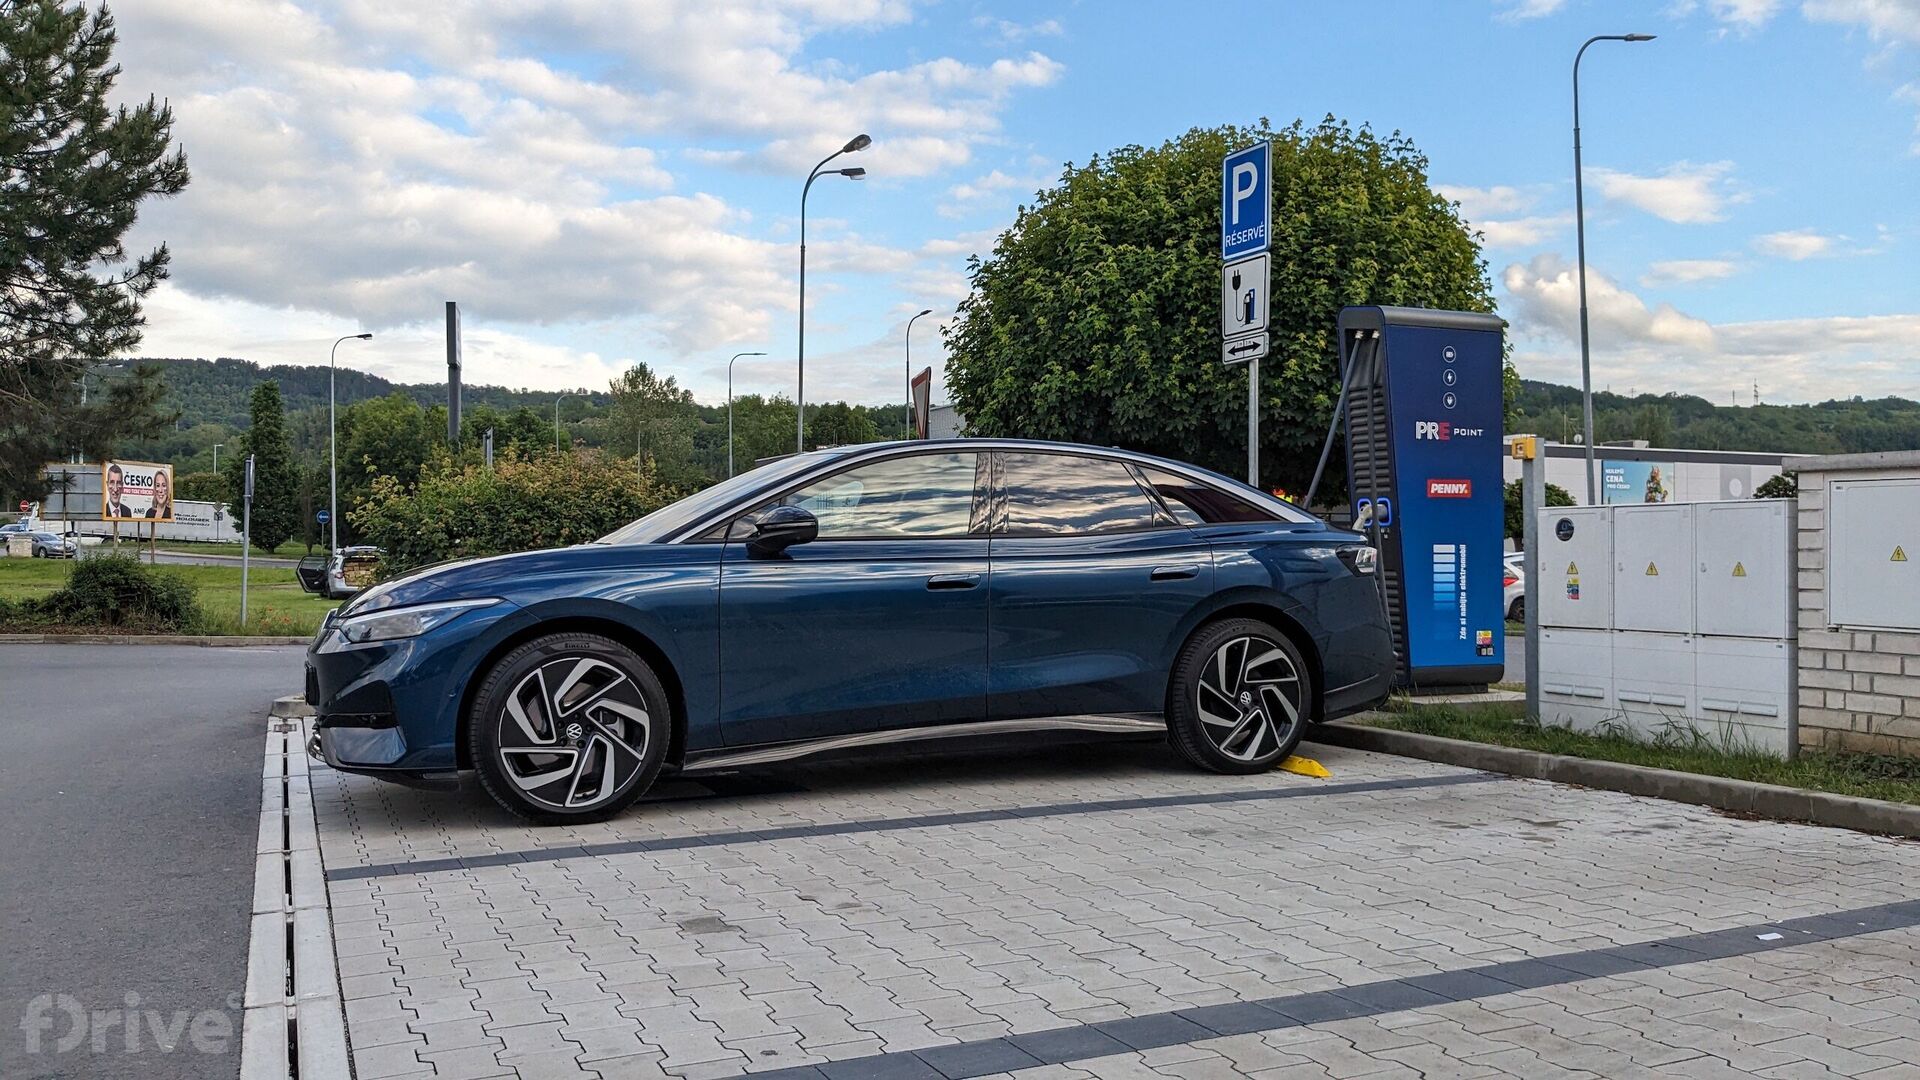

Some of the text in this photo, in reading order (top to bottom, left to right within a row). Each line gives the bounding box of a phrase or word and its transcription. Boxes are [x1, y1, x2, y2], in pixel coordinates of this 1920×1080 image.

[1232, 161, 1258, 225] P
[1225, 222, 1265, 248] RÉSERVÉ
[1415, 421, 1484, 441] PRE POINT
[124, 471, 153, 487] ČESKO
